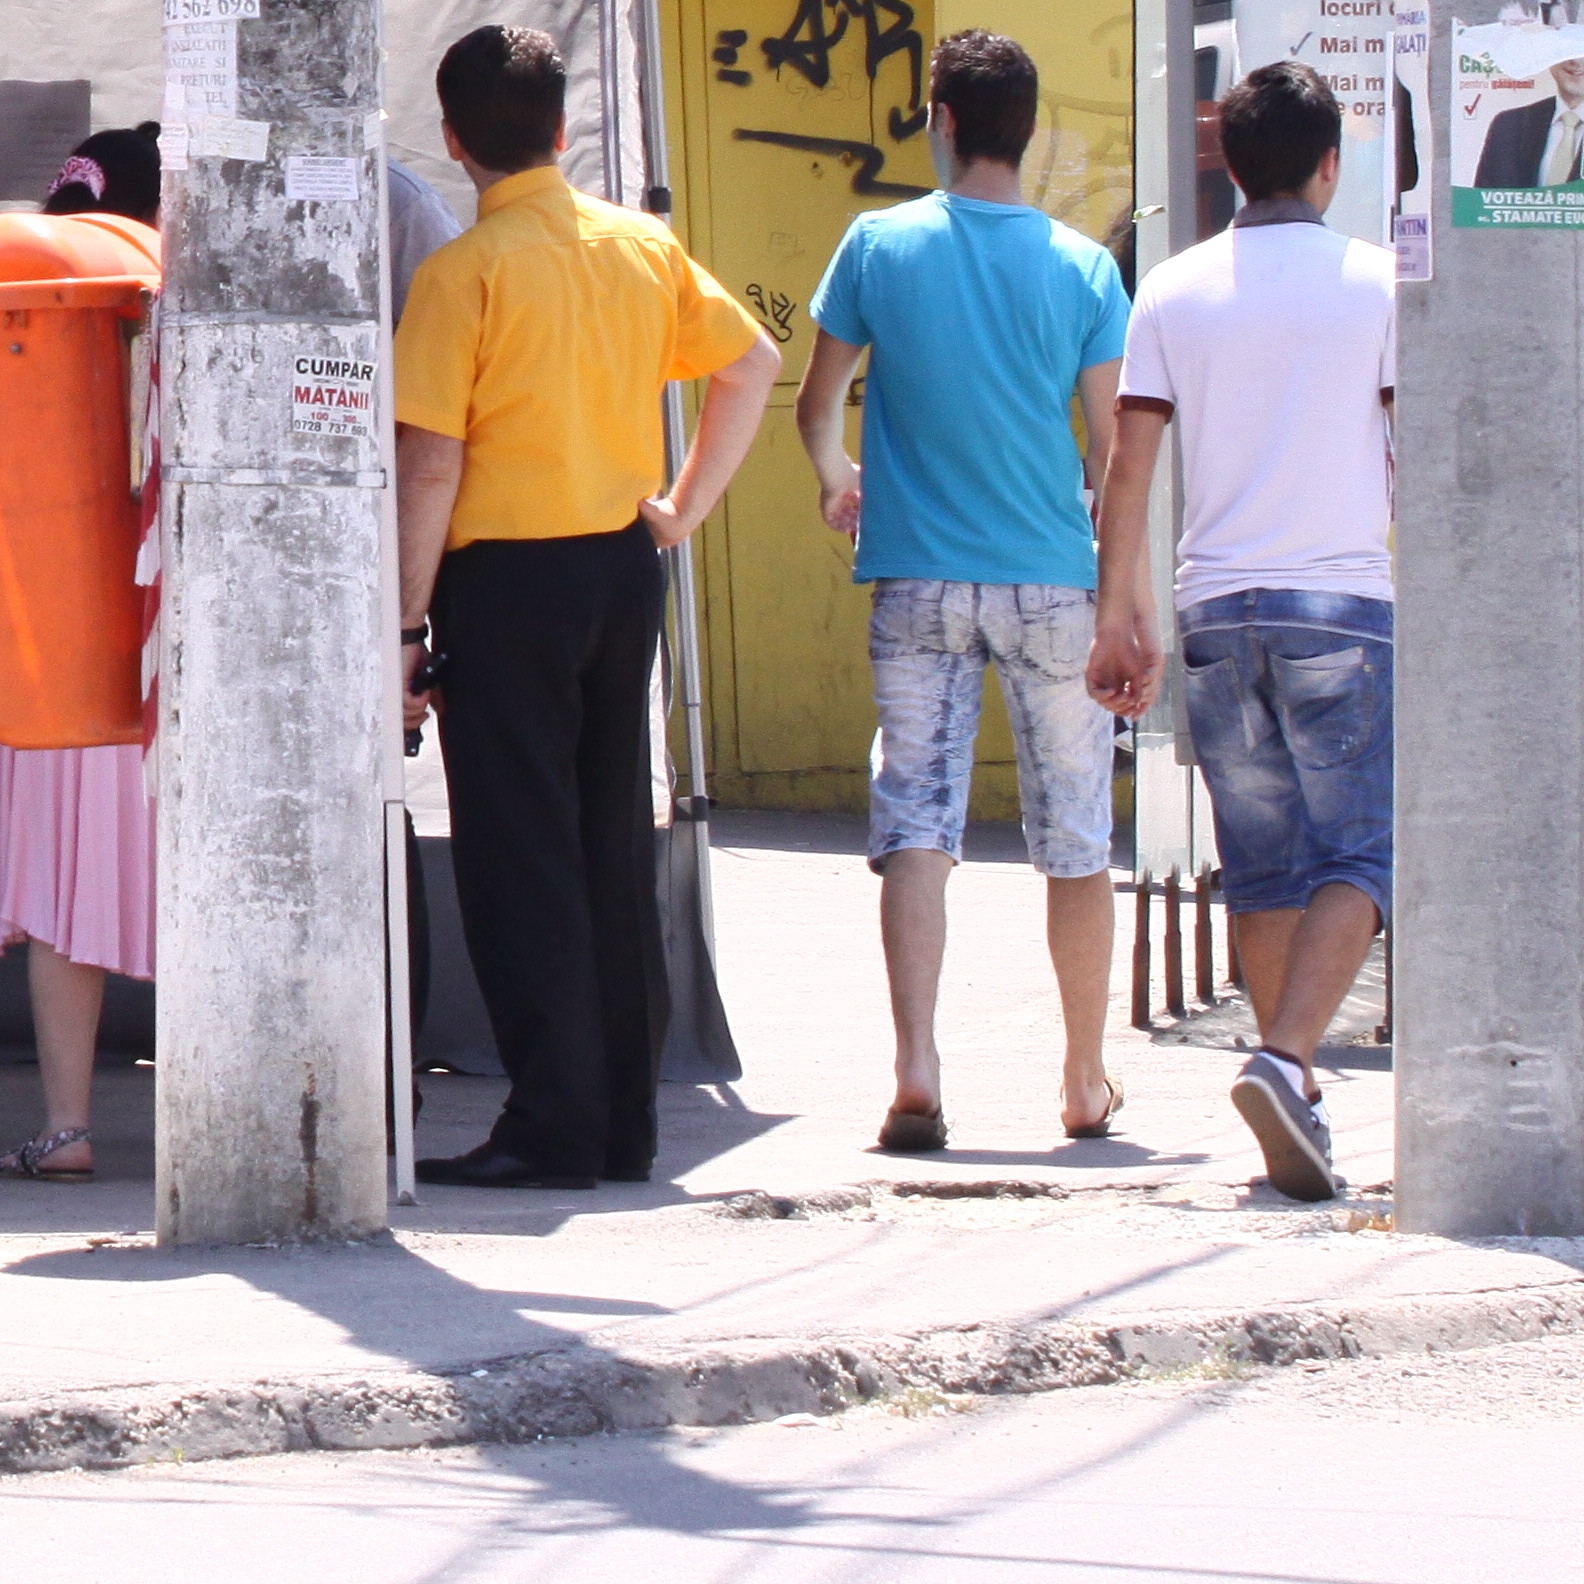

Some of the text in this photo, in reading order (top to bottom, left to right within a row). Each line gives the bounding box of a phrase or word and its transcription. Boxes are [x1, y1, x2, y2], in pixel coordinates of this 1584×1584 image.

[1320, 0, 1381, 16] locuri
[1320, 37, 1357, 53] Mai
[1353, 101, 1385, 116] ora
[1481, 189, 1554, 204] VOTEAZĂ
[1492, 210, 1561, 223] STAMATE
[329, 422, 347, 433] 737
